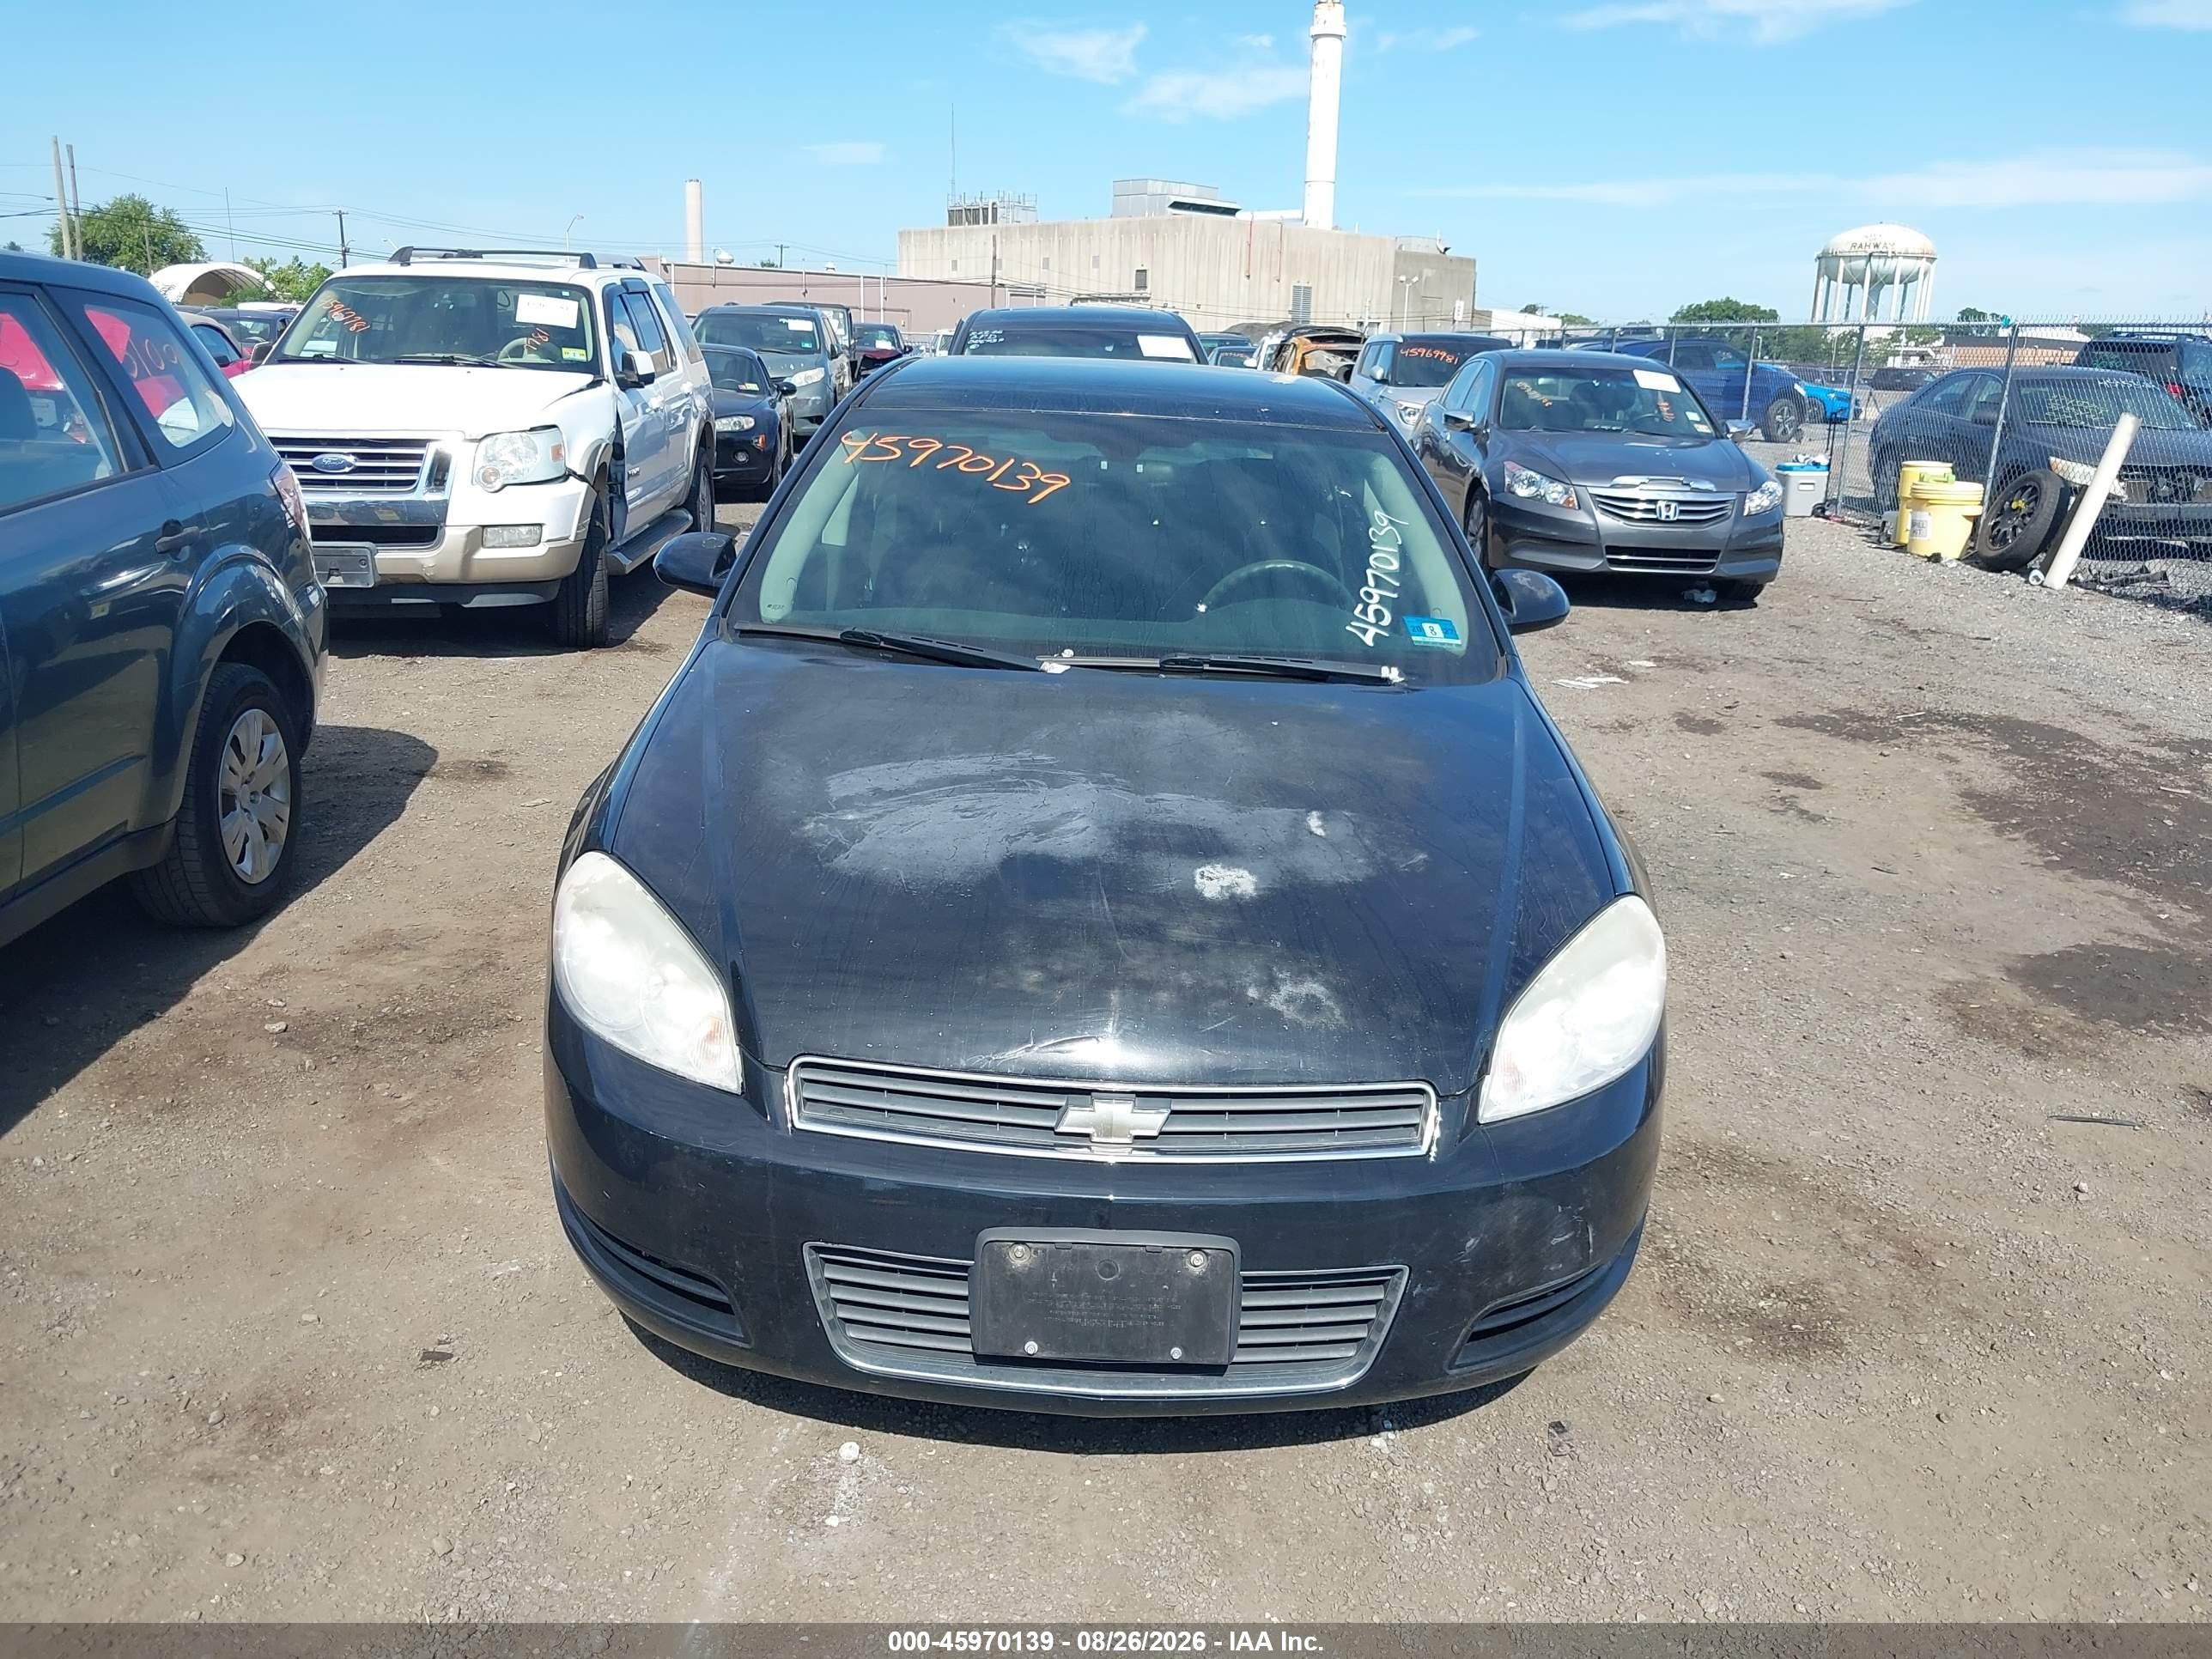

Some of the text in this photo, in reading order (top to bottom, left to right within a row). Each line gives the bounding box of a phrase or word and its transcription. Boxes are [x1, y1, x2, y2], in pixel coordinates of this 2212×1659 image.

[840, 430, 1072, 504] 45970139
[1345, 510, 1409, 647] 45970139
[1428, 625, 1437, 636] 8
